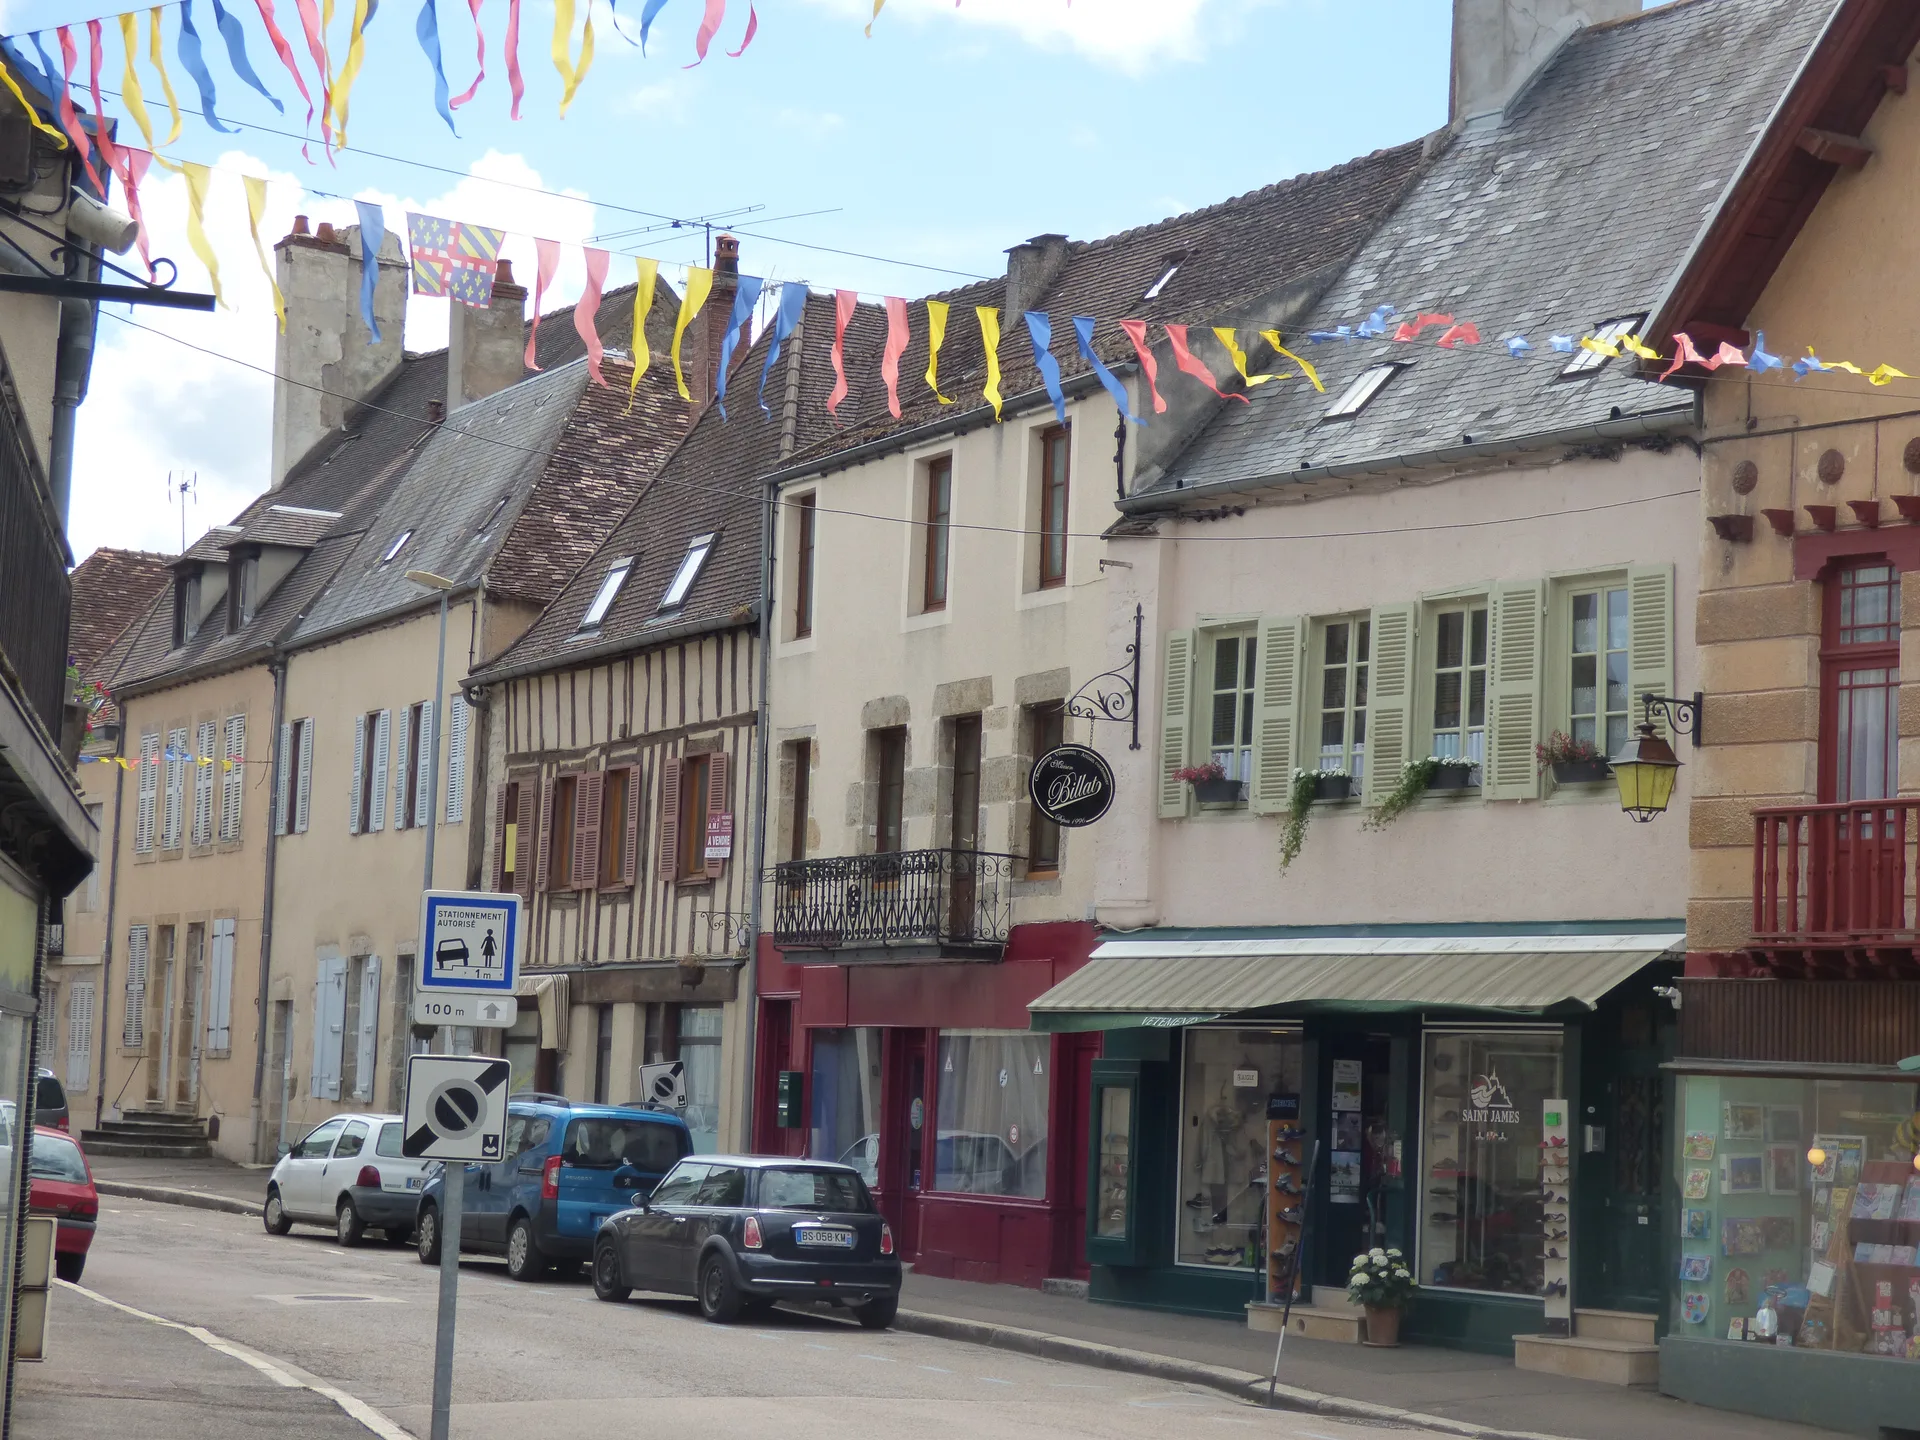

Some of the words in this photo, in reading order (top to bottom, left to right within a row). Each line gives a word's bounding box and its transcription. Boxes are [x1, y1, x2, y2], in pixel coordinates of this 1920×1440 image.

[1047, 771, 1102, 807] Billat
[707, 835, 712, 846] A
[712, 835, 730, 846] VENDRE
[438, 910, 502, 921] STATIONNEMENT
[437, 920, 476, 928] AUTORISÉ
[475, 969, 480, 979] 1
[424, 1003, 452, 1015] 100
[455, 1008, 465, 1016] m
[1462, 1109, 1489, 1122] SAINT
[1490, 1110, 1520, 1123] JAMES
